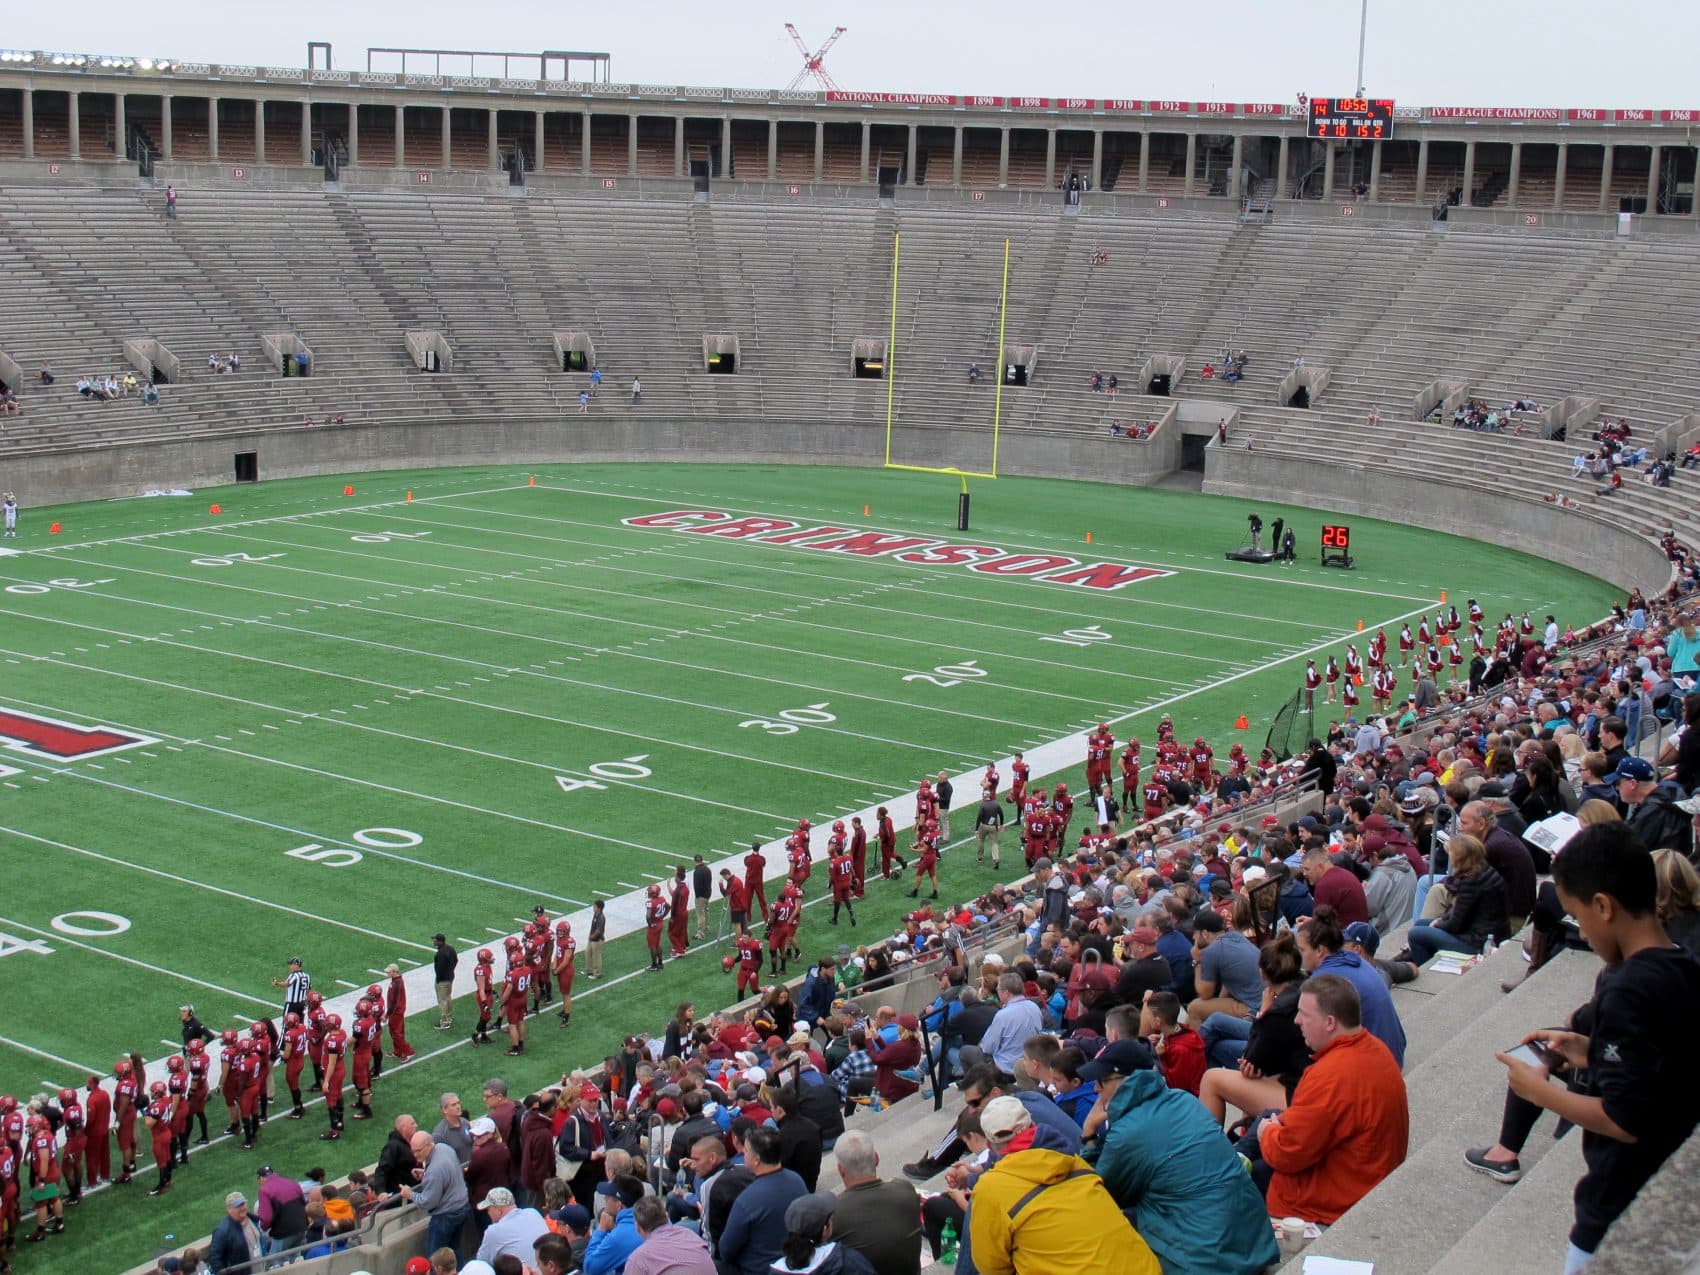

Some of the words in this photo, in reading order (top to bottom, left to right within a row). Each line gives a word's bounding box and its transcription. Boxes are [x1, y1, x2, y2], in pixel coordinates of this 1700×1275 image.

[833, 92, 886, 102] NATIONAL
[888, 94, 949, 104] CHAMPIONS
[972, 96, 994, 105] 1890
[1066, 99, 1087, 108] 1899
[1112, 100, 1133, 109] 1910
[1160, 101, 1180, 111] 1912
[1206, 103, 1226, 112] 1913
[1252, 104, 1273, 113] 1919
[1315, 105, 1327, 116] 14
[1340, 99, 1367, 111] 10:52
[1431, 107, 1449, 116] IVY
[1452, 108, 1494, 117] LEAGUE
[1496, 109, 1558, 119] CHAMPIONS
[1576, 109, 1597, 119] 1961
[1623, 110, 1645, 120] 1966
[1670, 111, 1691, 120] 1968
[1319, 125, 1326, 136] 2
[1335, 125, 1346, 137] 10
[1357, 126, 1368, 137] 15
[1374, 126, 1381, 137] 2
[1323, 525, 1348, 546] 26
[621, 510, 1180, 590] CRIMSON
[1039, 627, 1113, 647] 10
[902, 664, 988, 688] 20
[737, 708, 837, 736] 30
[554, 761, 652, 792] 40
[1146, 789, 1159, 801] 77
[284, 827, 423, 868] 50
[840, 860, 852, 875] 10
[741, 949, 752, 960] 13
[518, 973, 531, 991] 84
